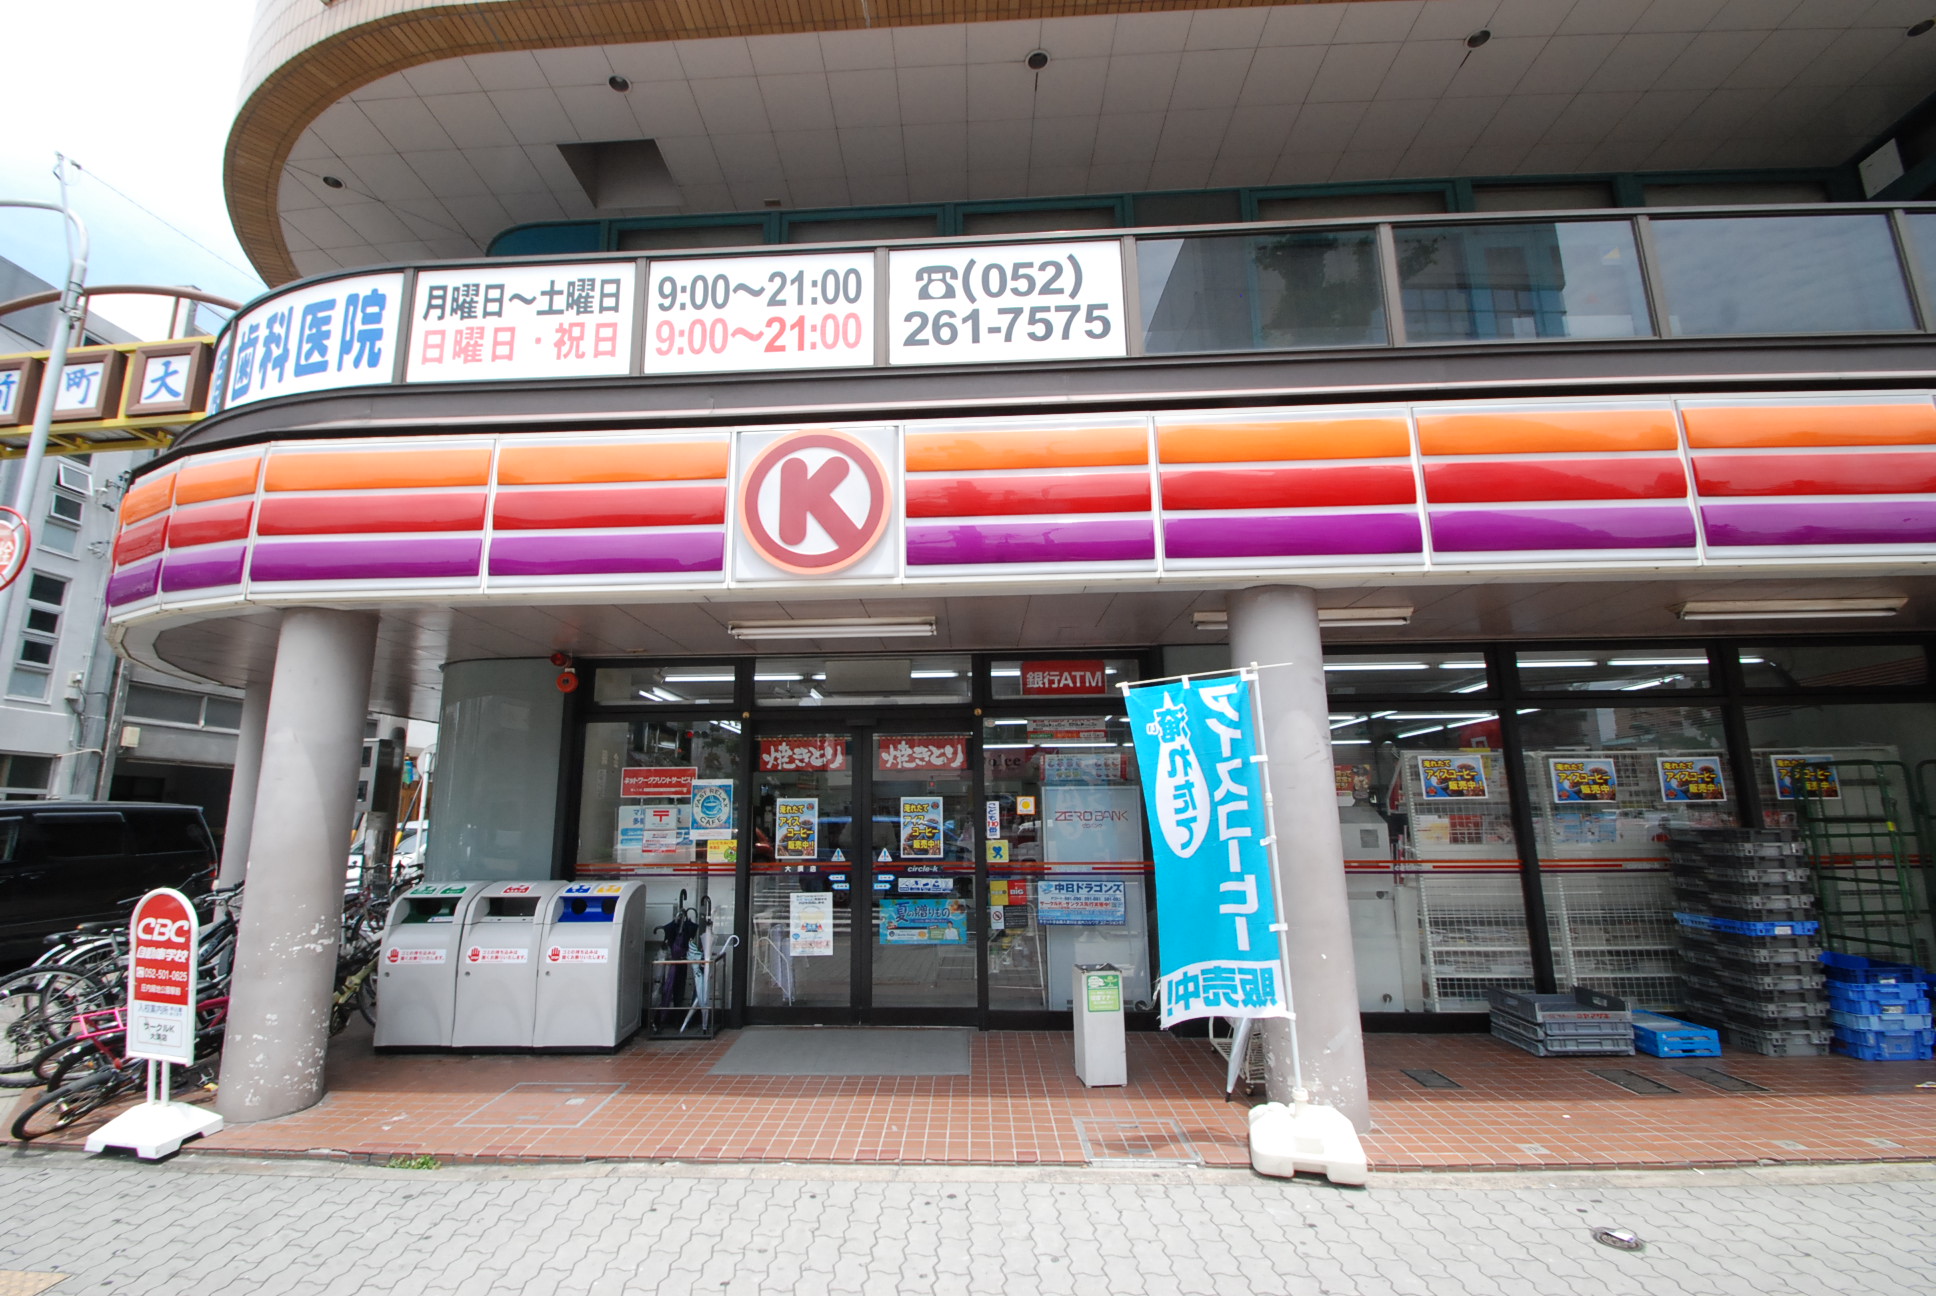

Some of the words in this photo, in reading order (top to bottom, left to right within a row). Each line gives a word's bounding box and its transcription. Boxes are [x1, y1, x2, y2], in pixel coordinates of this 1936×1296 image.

[903, 303, 1112, 347] 261-7575
[231, 288, 387, 402] 歯科医院
[421, 322, 618, 365] 日曜日・祝日
[1026, 671, 1103, 688] 銀行ATM
[762, 741, 843, 770] 焼きとり
[881, 740, 964, 768] 焼きとり
[1425, 769, 1478, 779] アイスコーヒー
[1558, 773, 1611, 783] アイスコーヒー
[1666, 772, 1717, 782] アイスコーヒー
[709, 788, 728, 808] RELAX
[700, 815, 723, 826] CAFE
[779, 816, 801, 827] アイス
[903, 815, 926, 826] アイス
[787, 828, 814, 837] コーヒー
[912, 827, 939, 836] コーヒー
[1055, 883, 1122, 893] 中日ドラゴンズ
[895, 901, 951, 922] 夏の贈りもの
[137, 917, 190, 943] CBC
[136, 945, 189, 963] 自動車学校
[143, 1022, 176, 1034] サークルK
